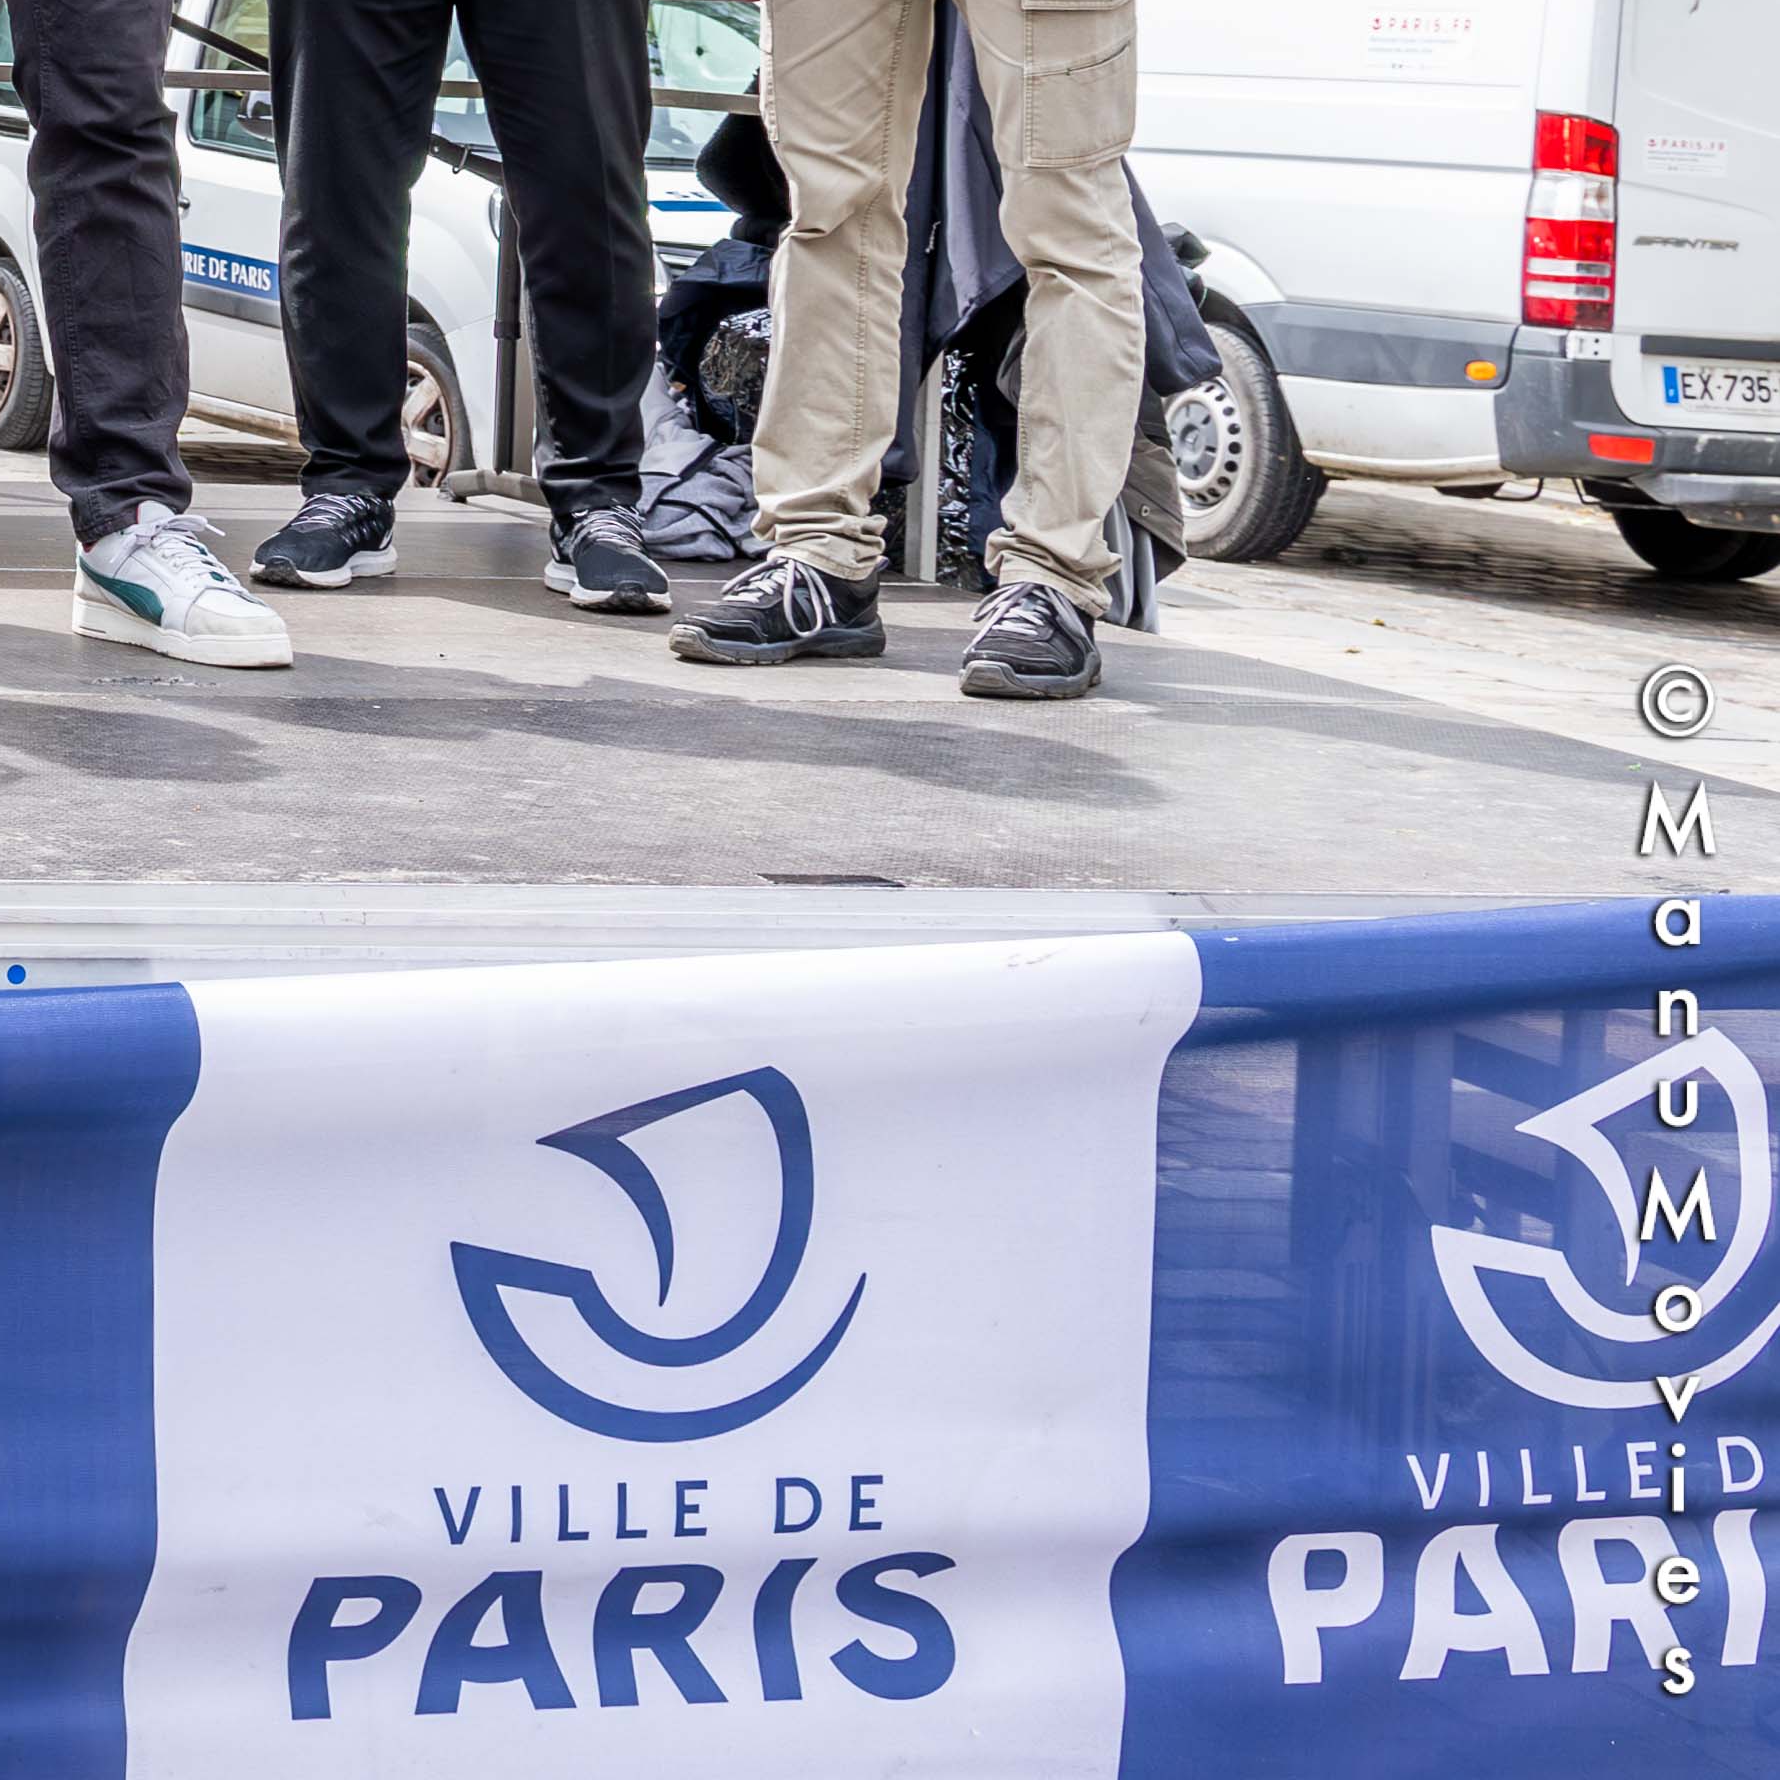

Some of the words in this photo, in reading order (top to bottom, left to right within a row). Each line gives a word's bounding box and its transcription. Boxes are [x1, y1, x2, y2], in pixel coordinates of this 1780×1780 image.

[208, 256, 228, 282] DE
[231, 261, 272, 292] PARIS
[433, 1479, 709, 1546] VILLE
[773, 1474, 884, 1535] DE
[1406, 1441, 1662, 1513] VILLE
[287, 1551, 957, 1721] PARIS
